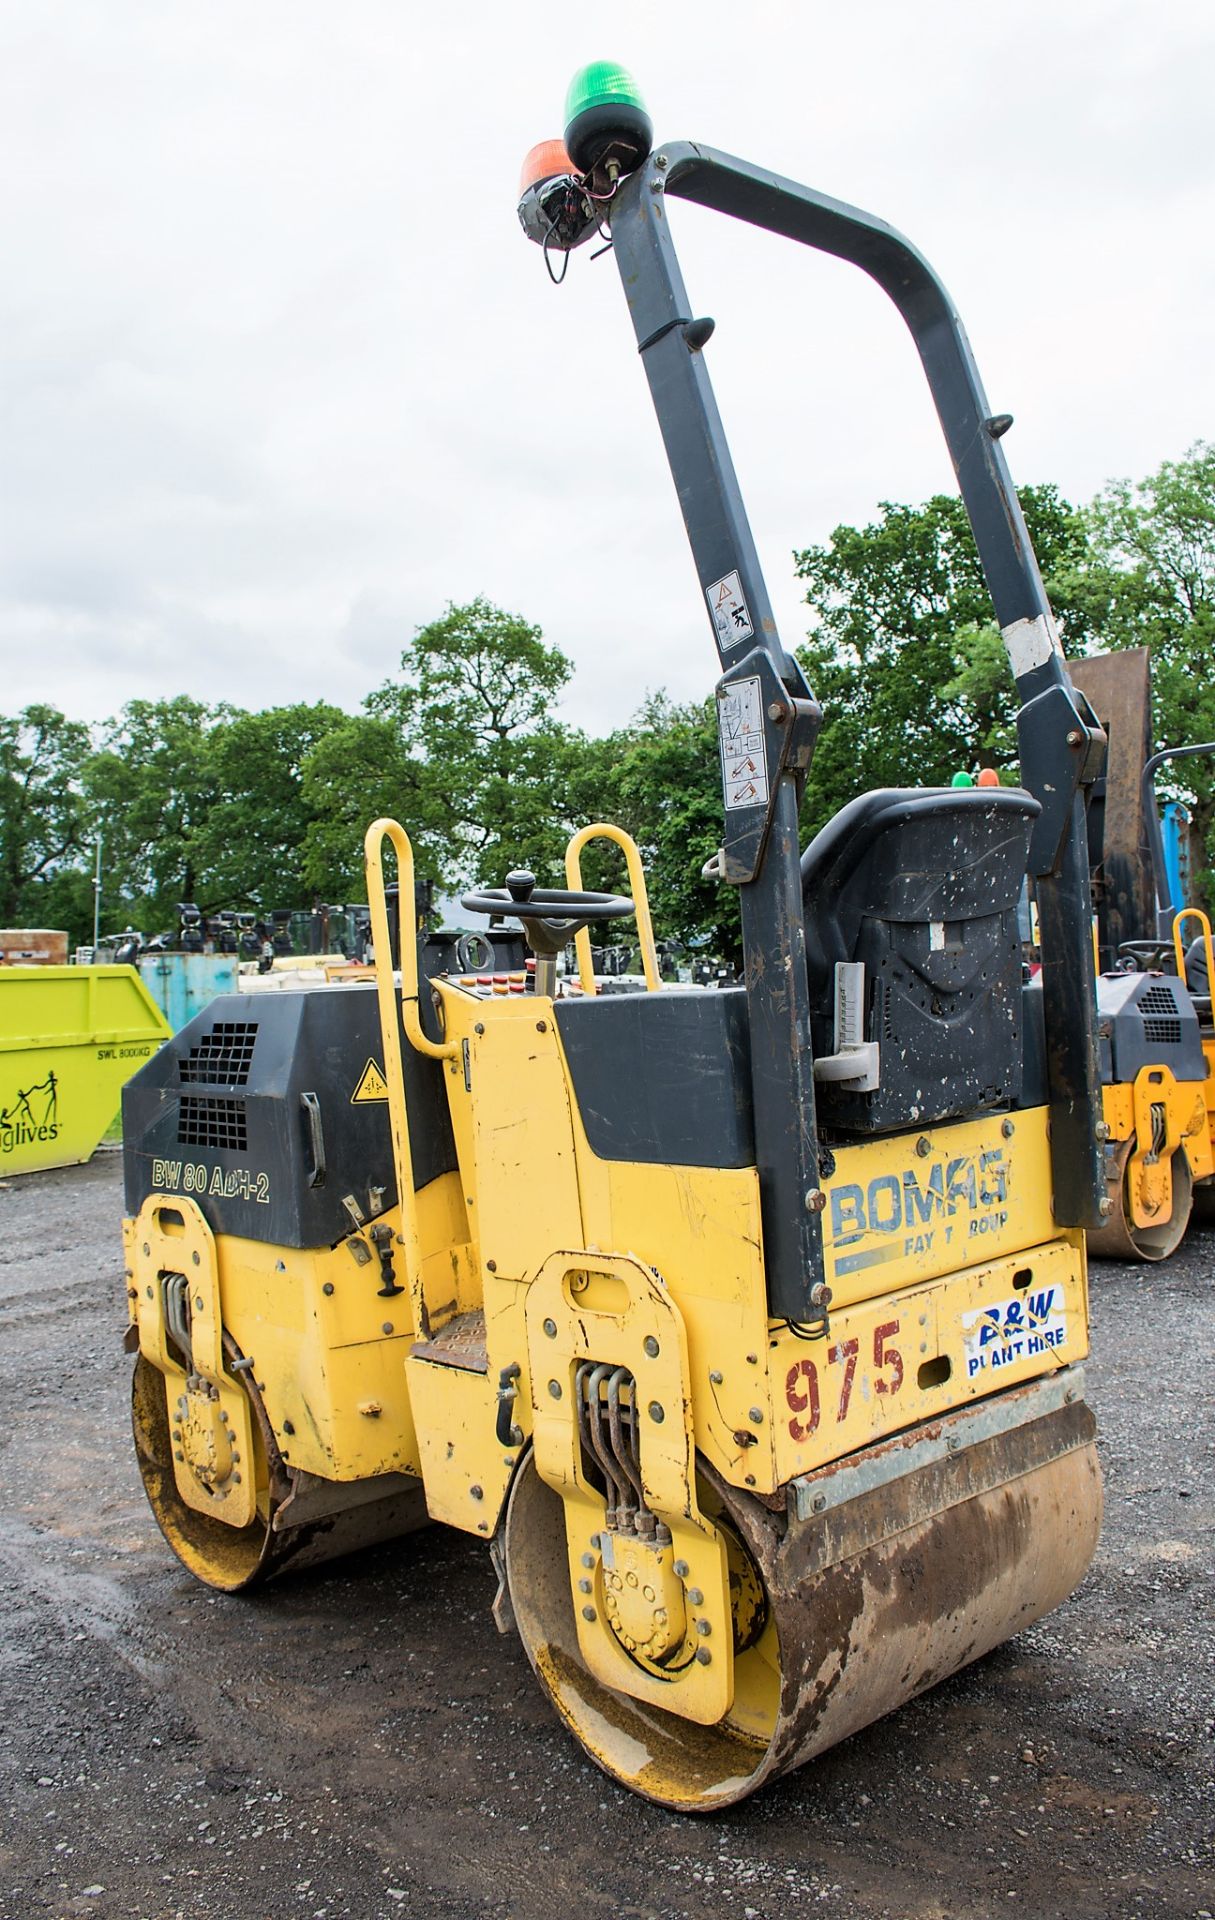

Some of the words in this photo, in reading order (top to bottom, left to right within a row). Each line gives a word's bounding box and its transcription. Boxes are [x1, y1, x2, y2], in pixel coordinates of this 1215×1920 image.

[97, 1049, 117, 1060] SWL
[119, 1047, 150, 1059] 8000KG
[152, 1159, 182, 1189] BW
[183, 1163, 207, 1193] 80
[830, 1149, 1008, 1248] BOMAG
[968, 1341, 1024, 1376] PLANT
[1028, 1327, 1064, 1354] HIRE
[785, 1320, 904, 1441] 975
